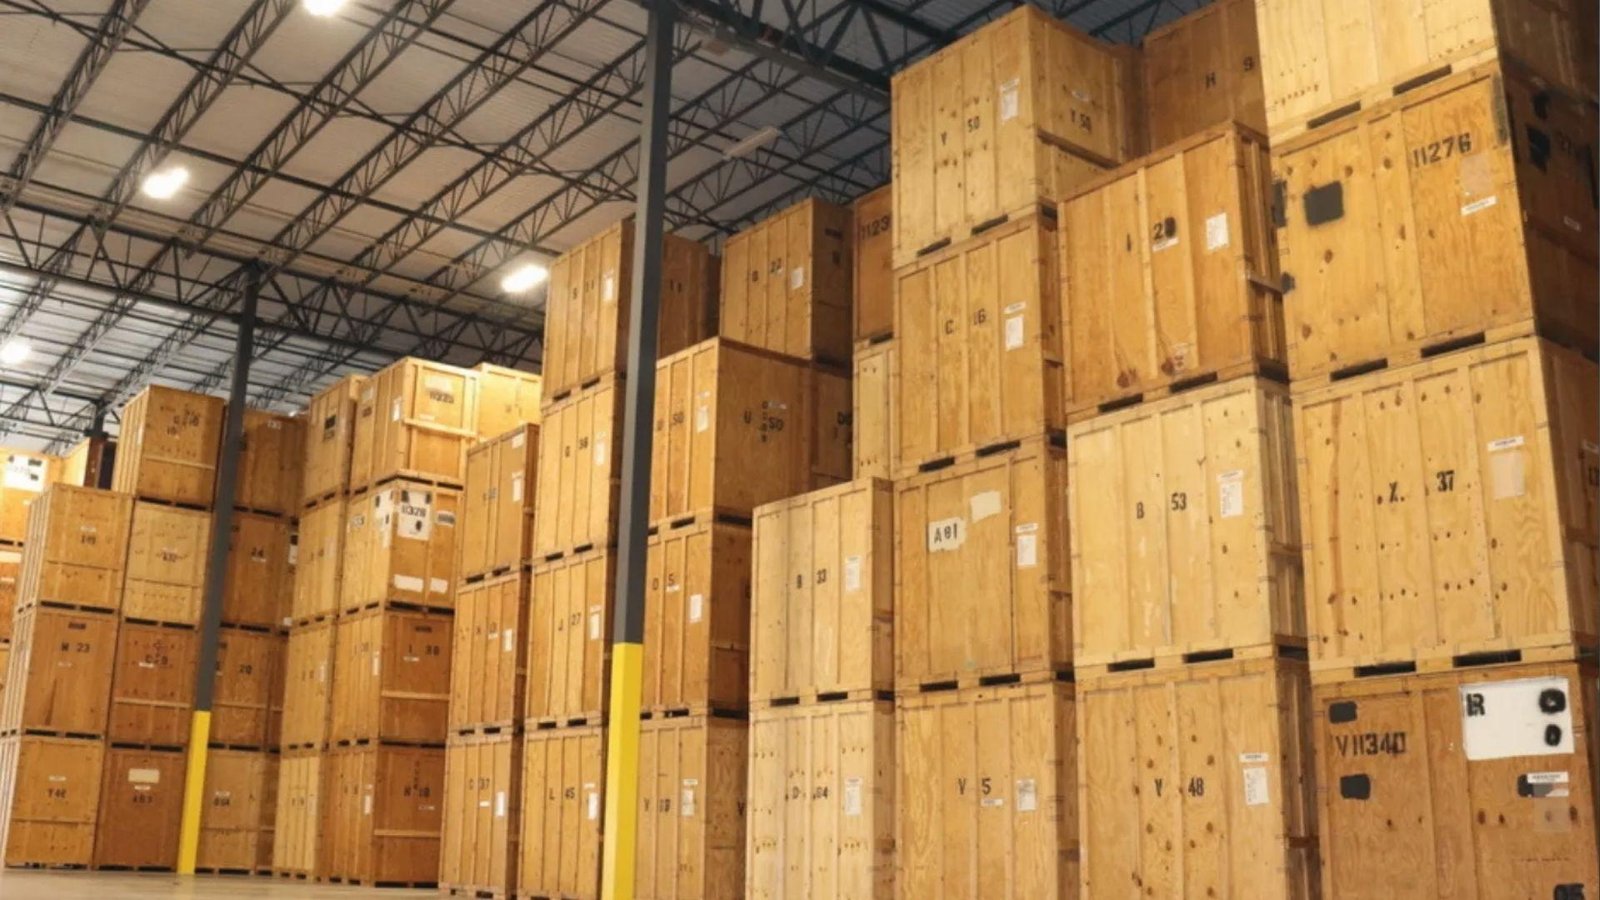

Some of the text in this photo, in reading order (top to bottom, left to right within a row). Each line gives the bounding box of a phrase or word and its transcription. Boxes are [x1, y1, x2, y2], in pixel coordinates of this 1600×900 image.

[1170, 491, 1188, 511] 53
[980, 776, 992, 796] 5
[1187, 776, 1205, 798] 48
